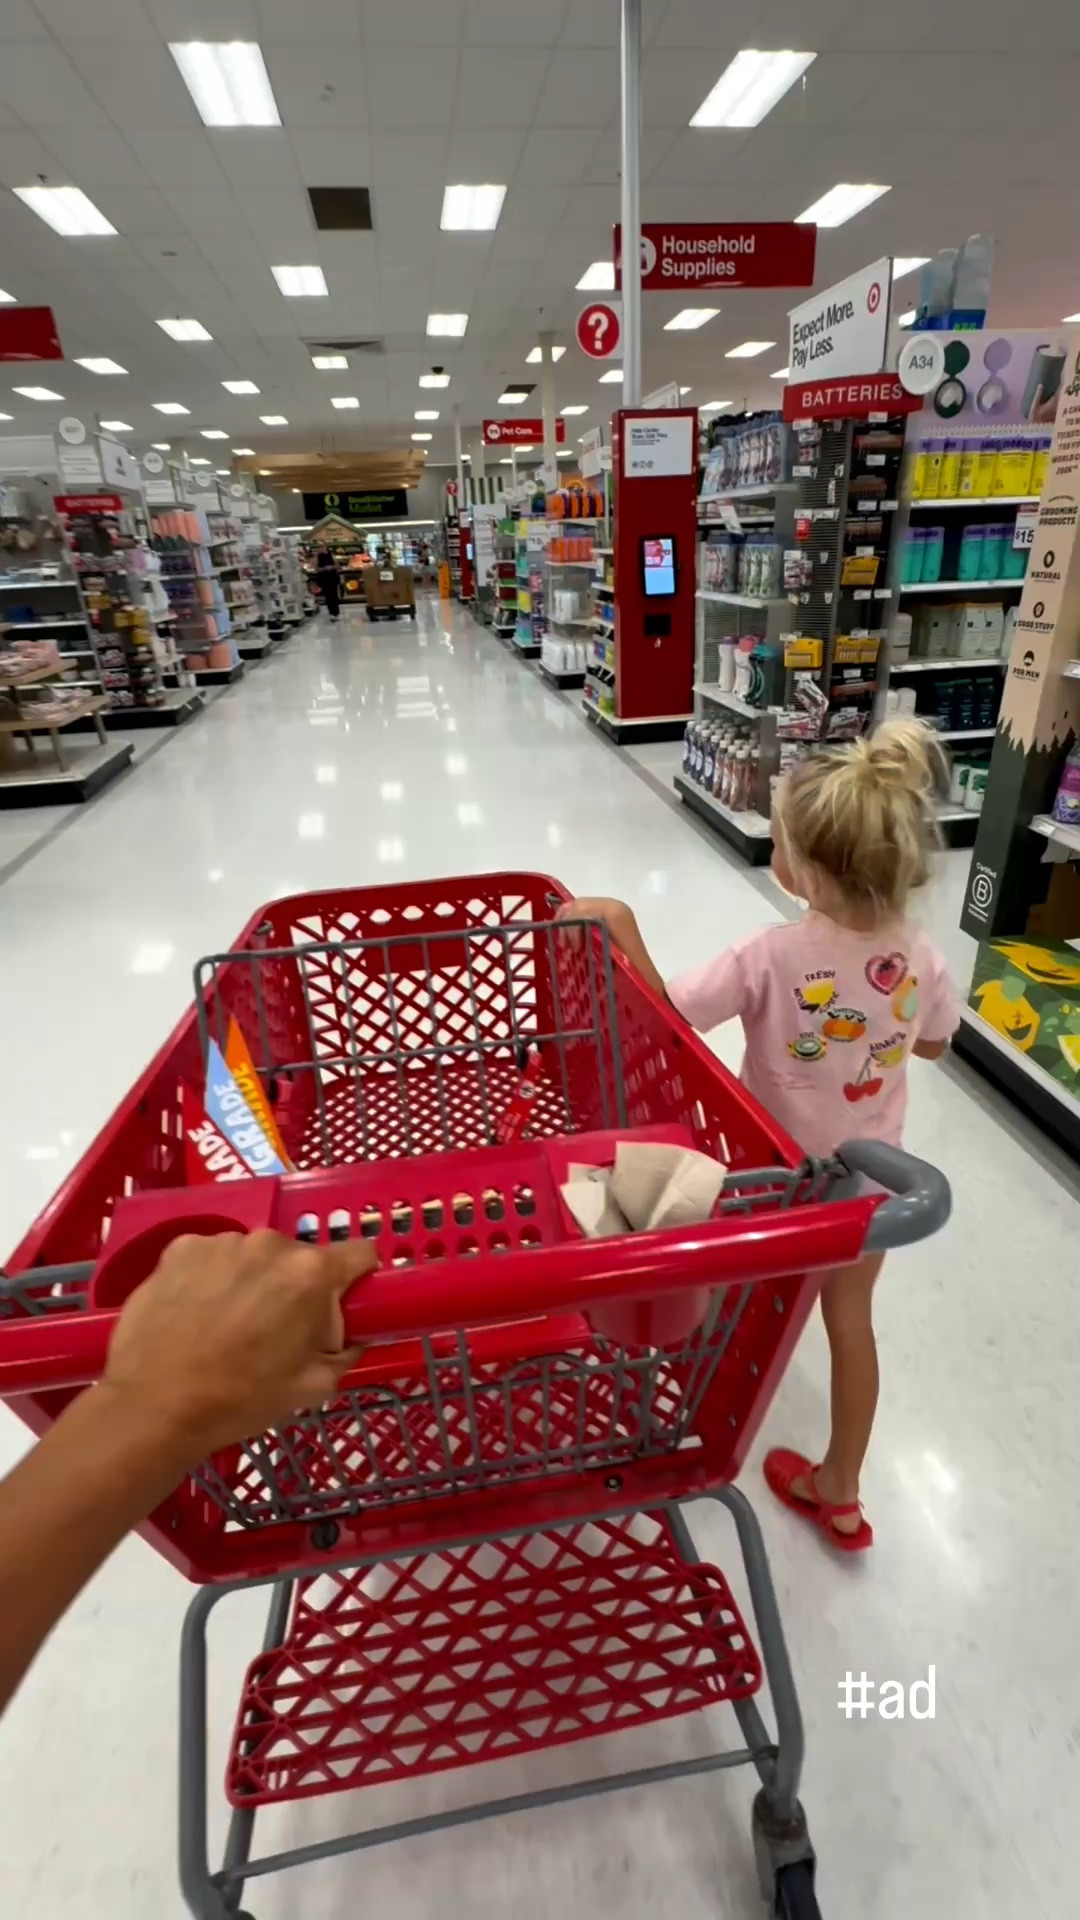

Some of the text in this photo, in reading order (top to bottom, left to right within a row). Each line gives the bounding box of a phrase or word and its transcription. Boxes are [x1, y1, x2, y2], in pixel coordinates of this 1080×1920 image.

[661, 235, 755, 254] Household
[661, 257, 736, 280] Supplies
[793, 300, 855, 345] Expect More.
[792, 347, 809, 369] Pay
[908, 355, 934, 369] A34
[802, 383, 903, 408] BATTERIES
[501, 426, 533, 436] Pet Care
[1040, 506, 1079, 517] GROOMING
[1038, 516, 1076, 526] PRODUCTS
[1015, 529, 1035, 544] $15
[1030, 571, 1061, 580] NATURAL
[1018, 620, 1035, 629] GOOD
[1034, 622, 1055, 631] STUFF
[1013, 667, 1025, 676] FOR
[1025, 670, 1040, 679] MEN
[804, 969, 837, 983] FRESH
[213, 1078, 276, 1171] GRADE
